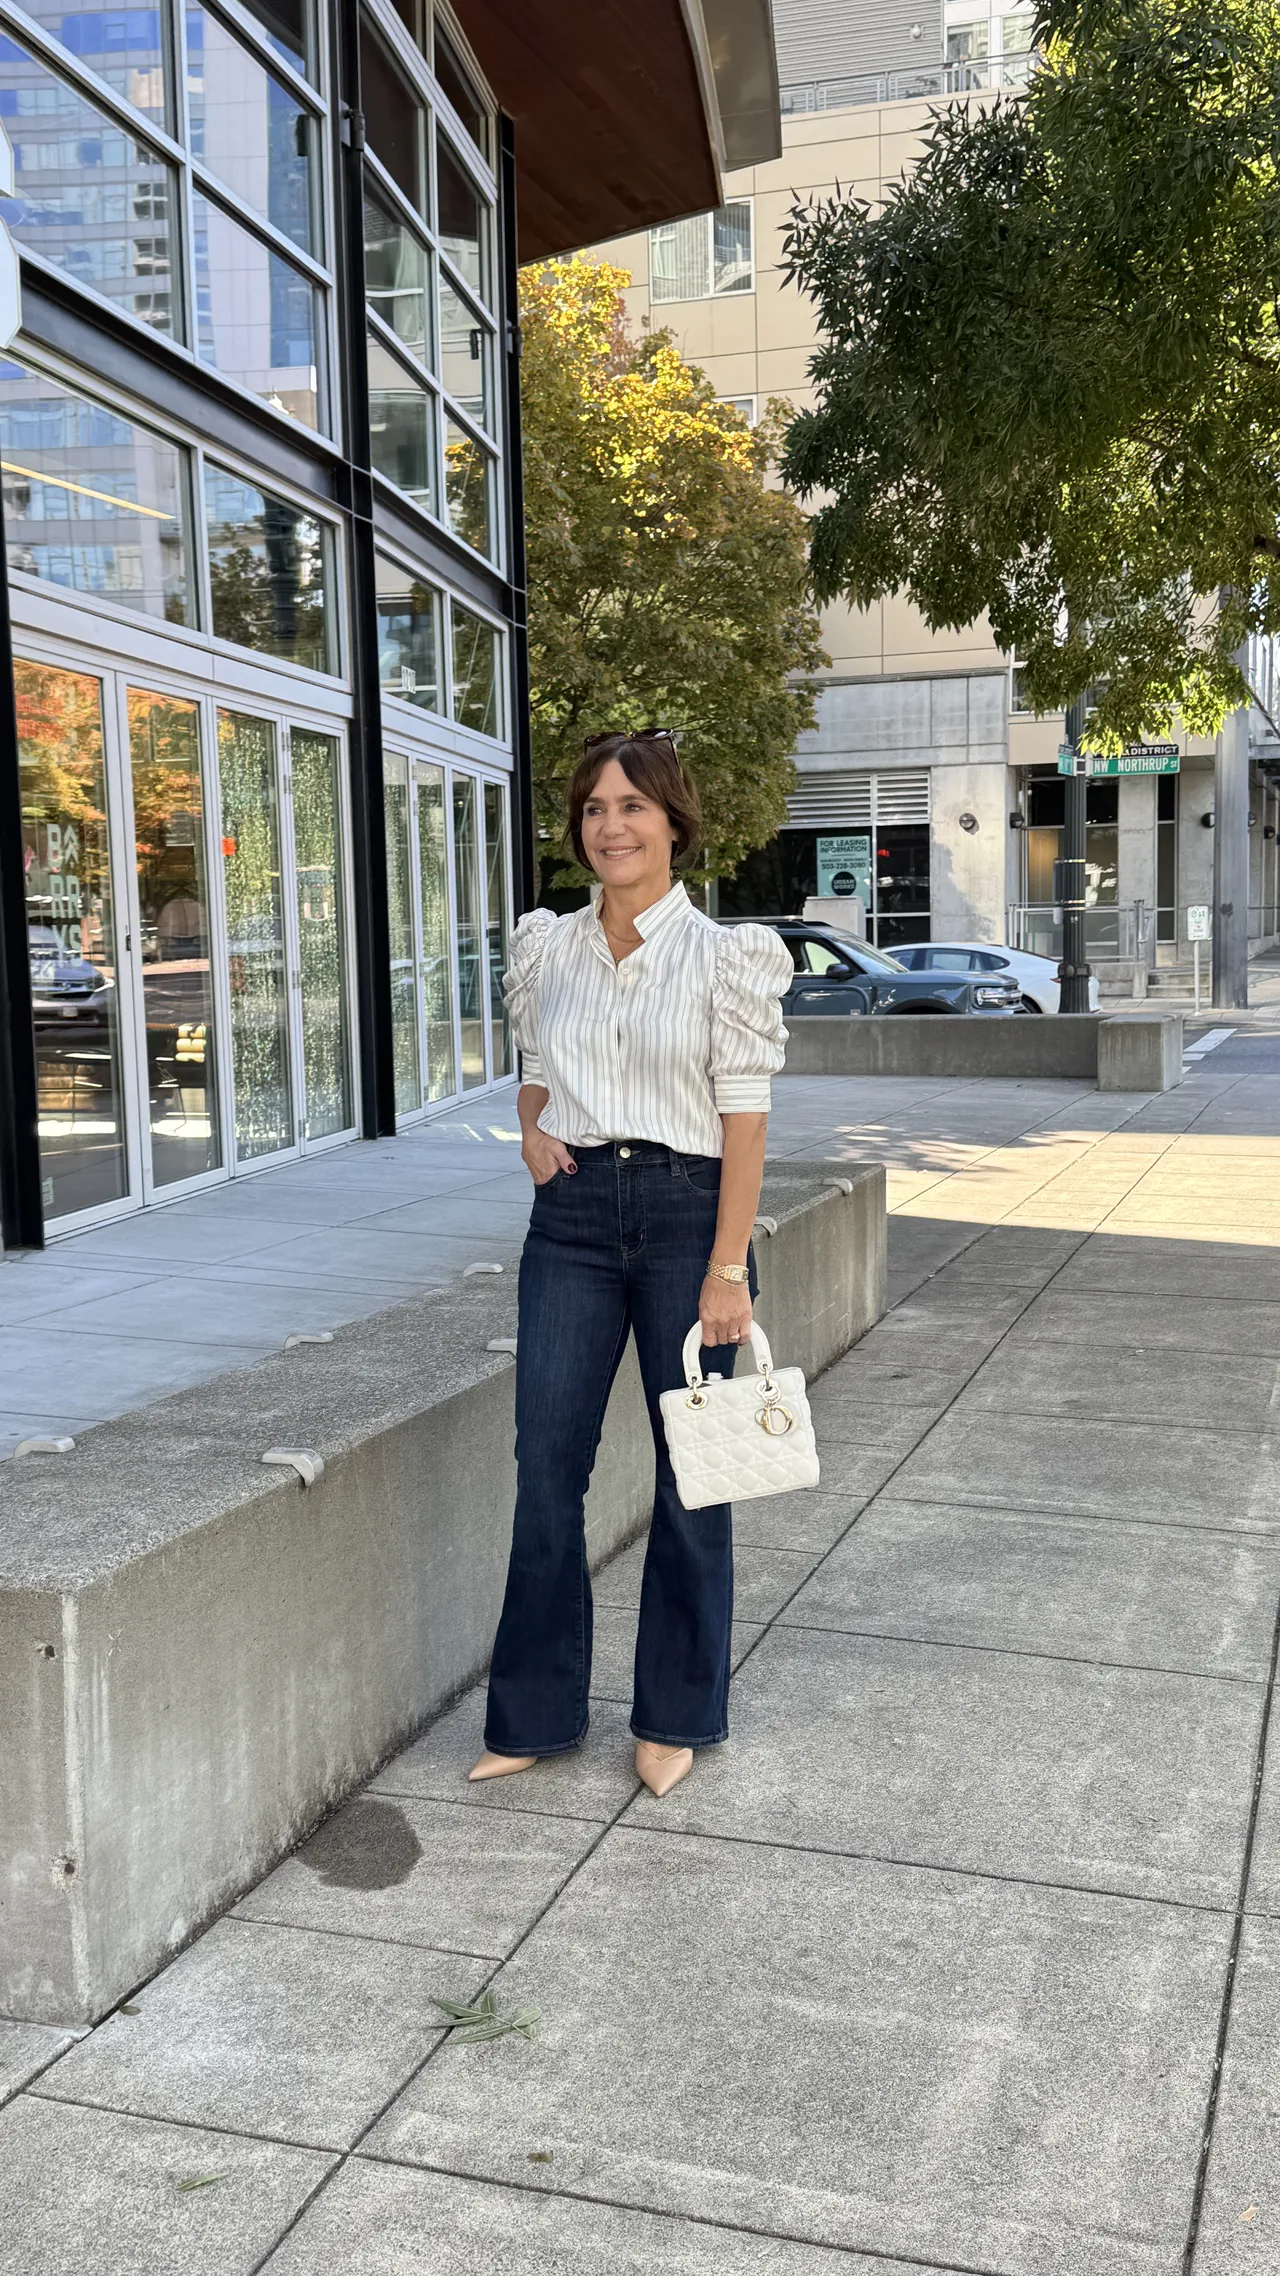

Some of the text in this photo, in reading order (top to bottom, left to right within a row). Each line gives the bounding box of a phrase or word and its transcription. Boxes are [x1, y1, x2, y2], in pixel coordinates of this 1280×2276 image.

[1130, 745, 1178, 756] DISTRICT
[1094, 760, 1109, 773] NW
[1117, 757, 1169, 772] NORTHRUP
